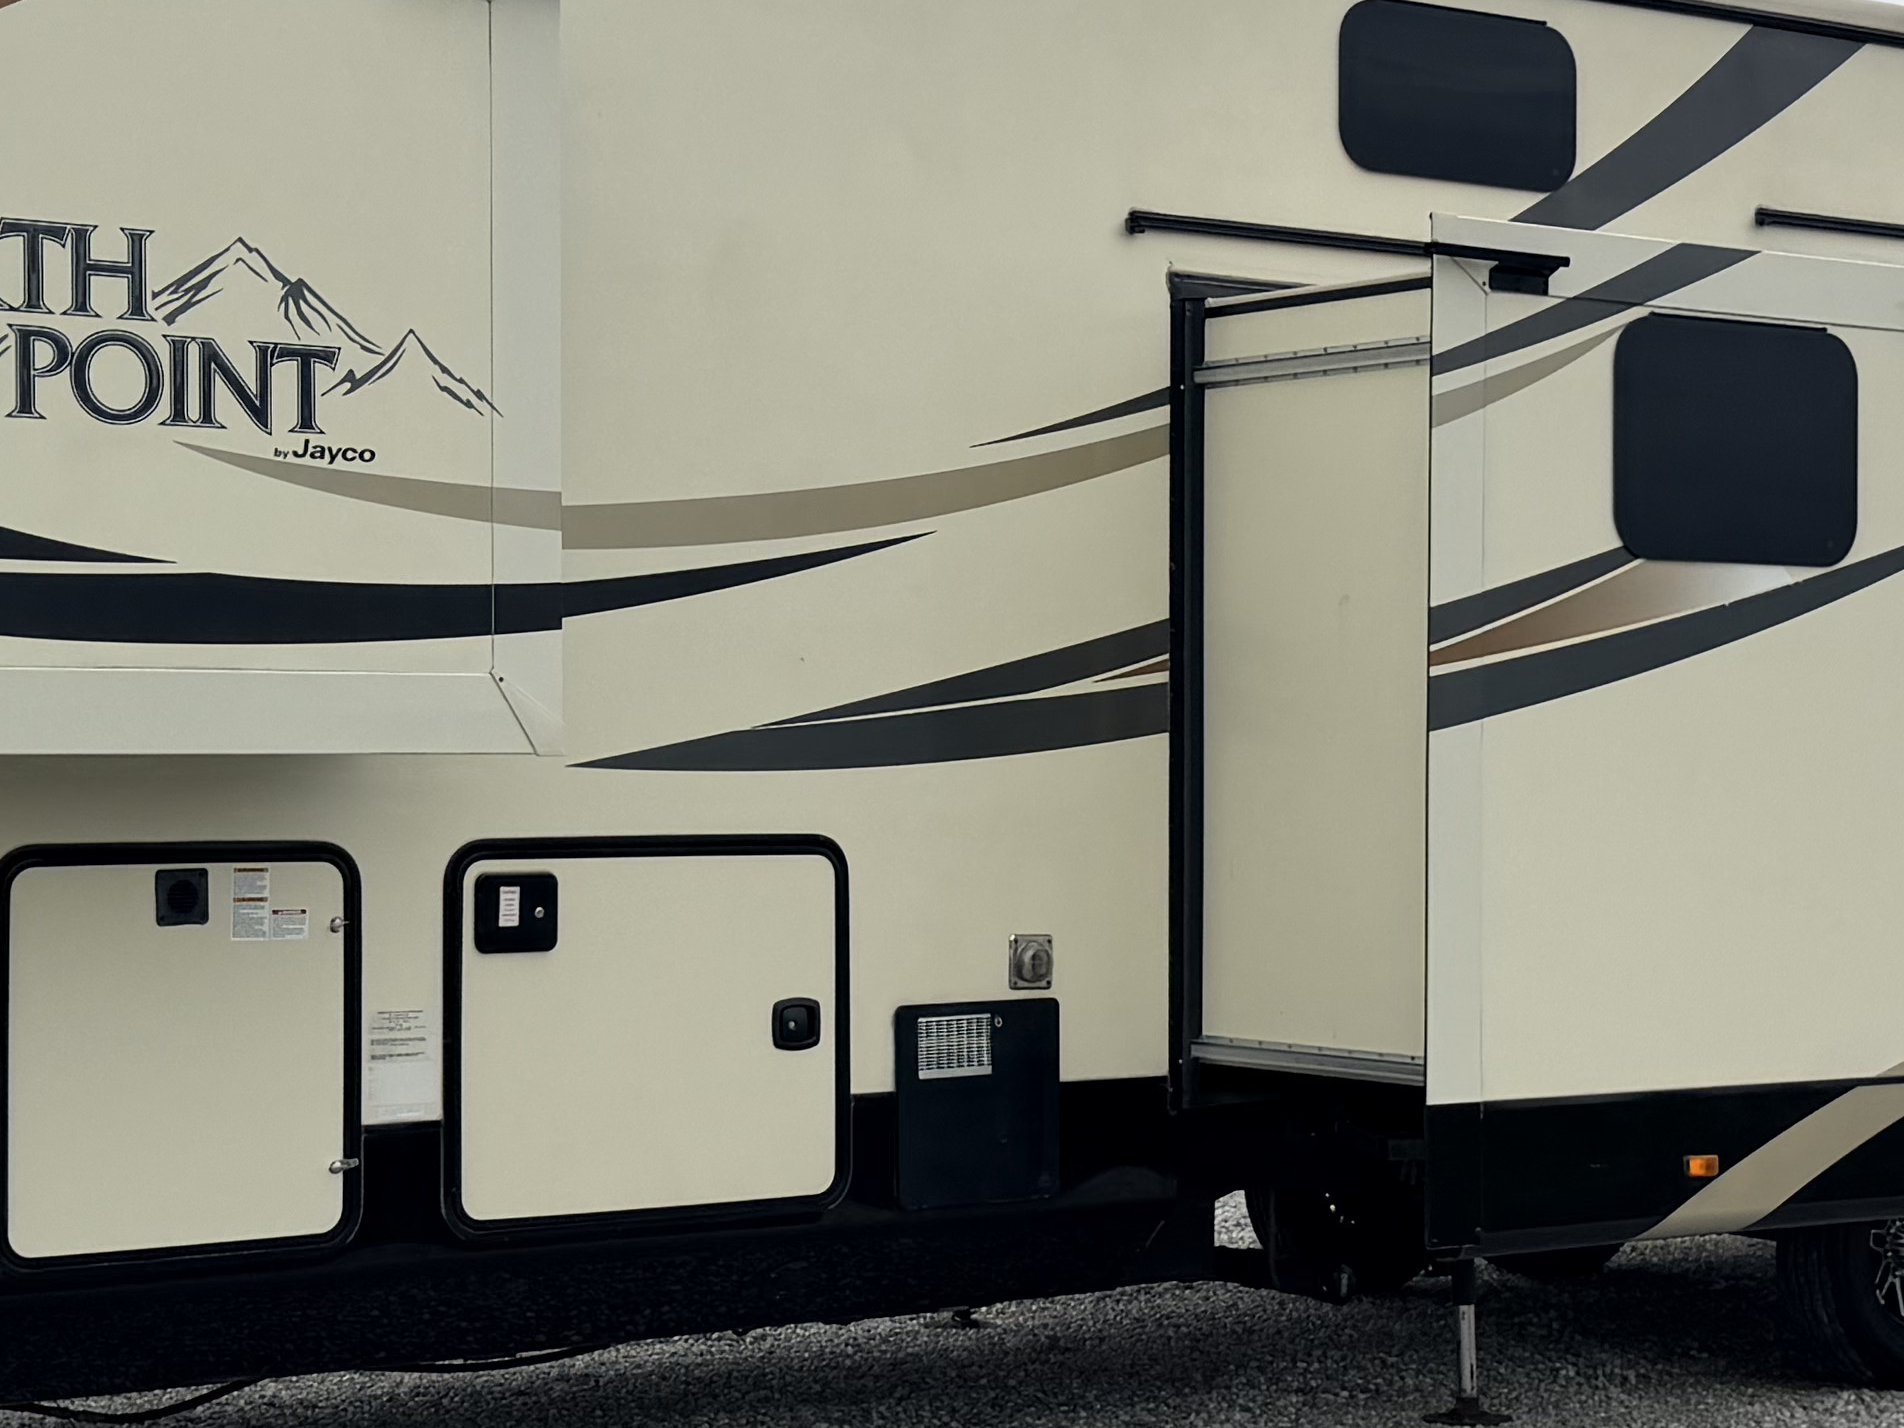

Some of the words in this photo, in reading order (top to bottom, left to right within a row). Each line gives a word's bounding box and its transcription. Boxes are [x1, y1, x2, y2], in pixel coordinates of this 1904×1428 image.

[5, 324, 341, 436] POINT
[274, 447, 290, 459] by
[292, 438, 376, 465] Jayco
